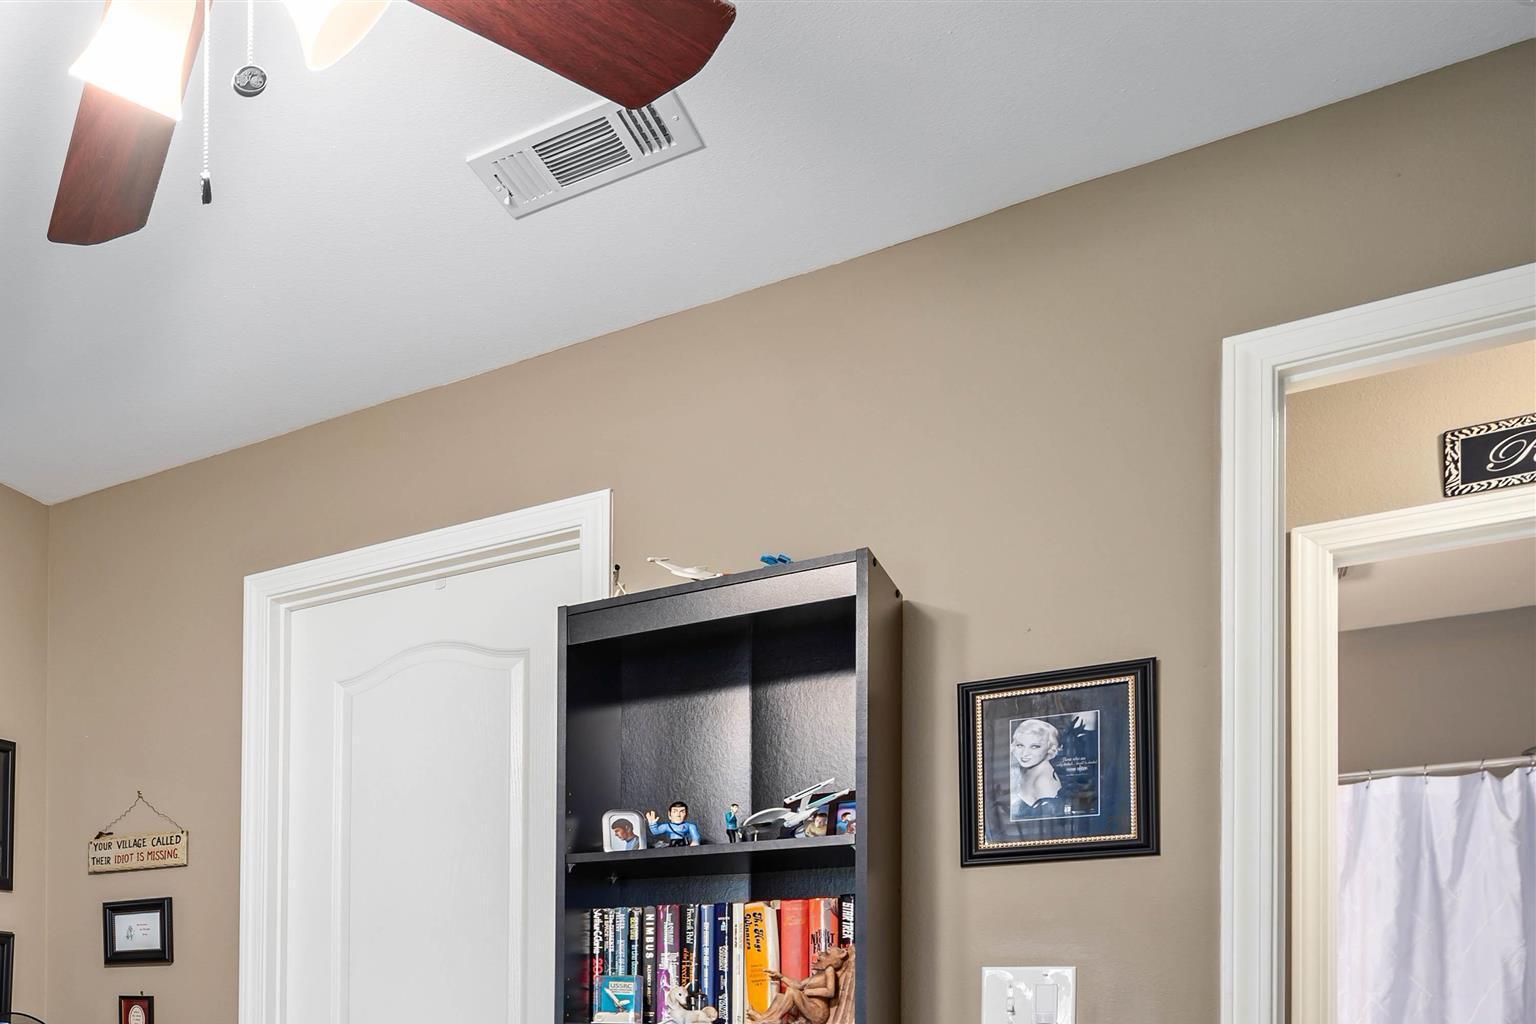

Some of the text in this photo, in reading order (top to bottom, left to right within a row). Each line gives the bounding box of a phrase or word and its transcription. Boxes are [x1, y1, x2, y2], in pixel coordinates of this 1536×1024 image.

[91, 856, 112, 866] THEIR
[114, 852, 134, 864] IDIOT
[136, 851, 145, 862] IS
[93, 834, 182, 852] YOUR VILLAGE CALLED
[645, 913, 655, 960] NIMBUS
[685, 908, 695, 945] Frederik Pohl
[744, 913, 752, 951] Winners
[752, 911, 763, 926] The
[841, 901, 854, 940] STAR TREK
